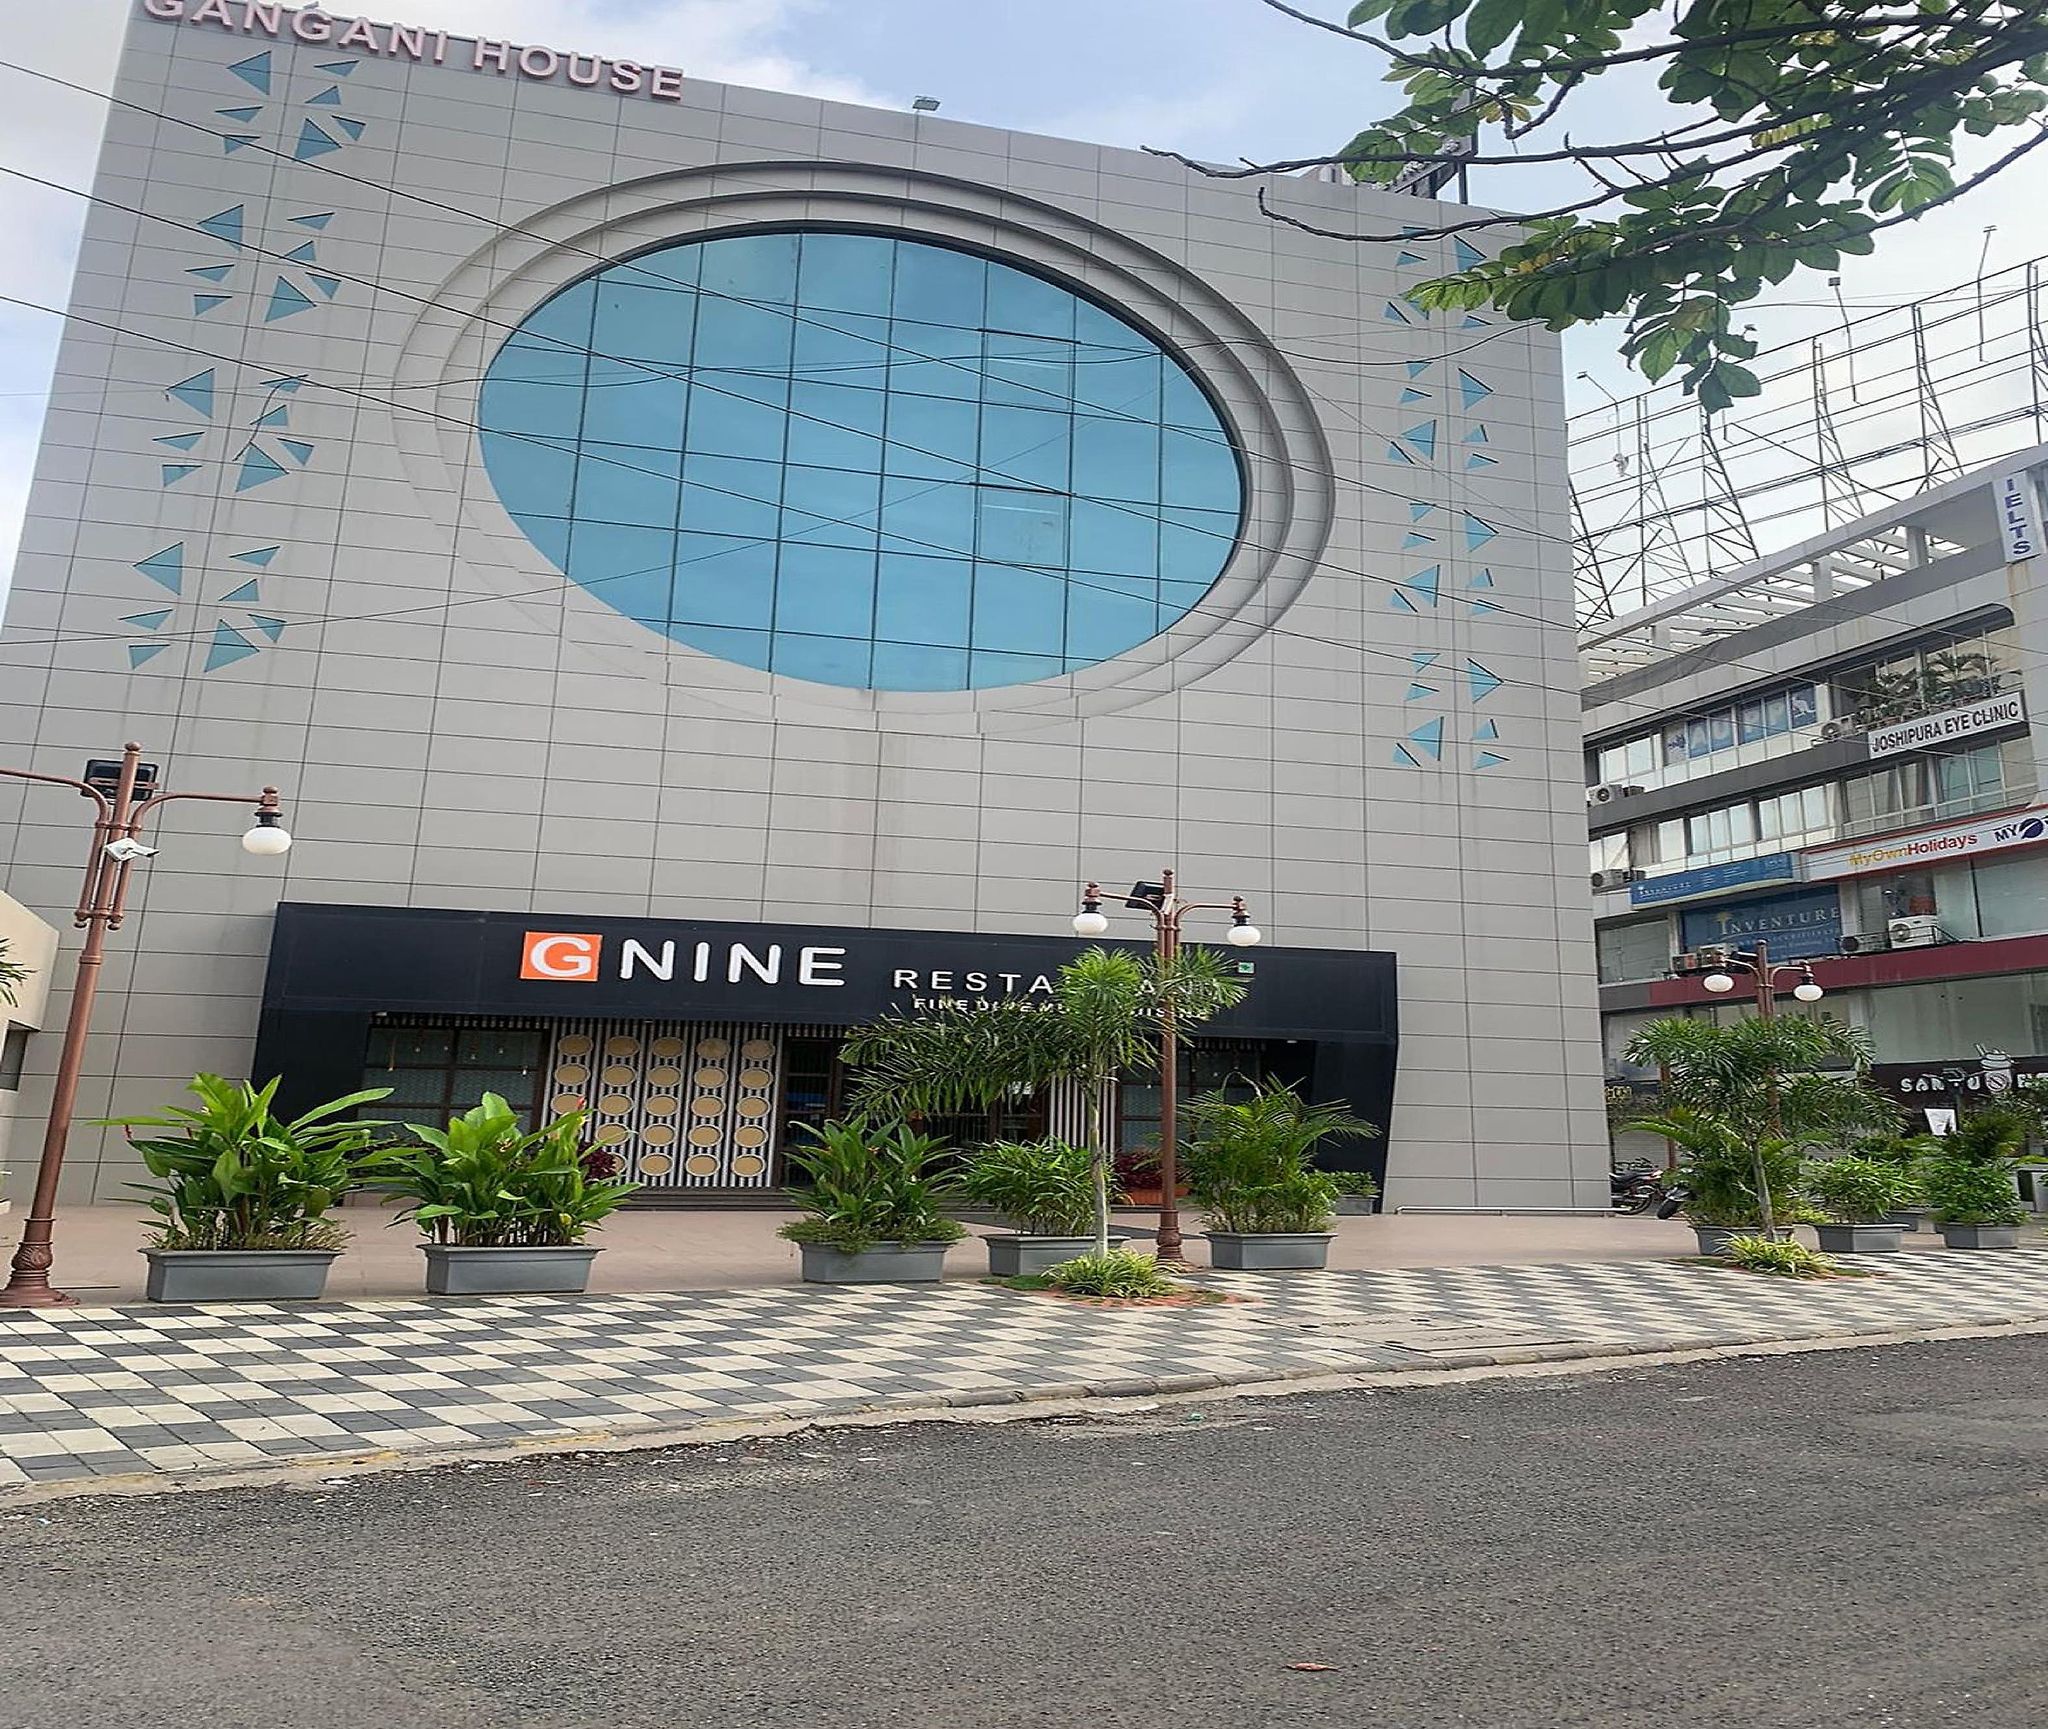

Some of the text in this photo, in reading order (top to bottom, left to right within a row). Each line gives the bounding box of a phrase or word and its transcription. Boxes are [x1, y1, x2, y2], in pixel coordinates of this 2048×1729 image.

[473, 36, 684, 102] HOUSE
[2003, 478, 2032, 556] IELTS
[1872, 701, 2019, 753] JOSHIPURA EYE CLINIC
[1721, 907, 1841, 935] INVENTURE
[530, 935, 846, 986] G NINE
